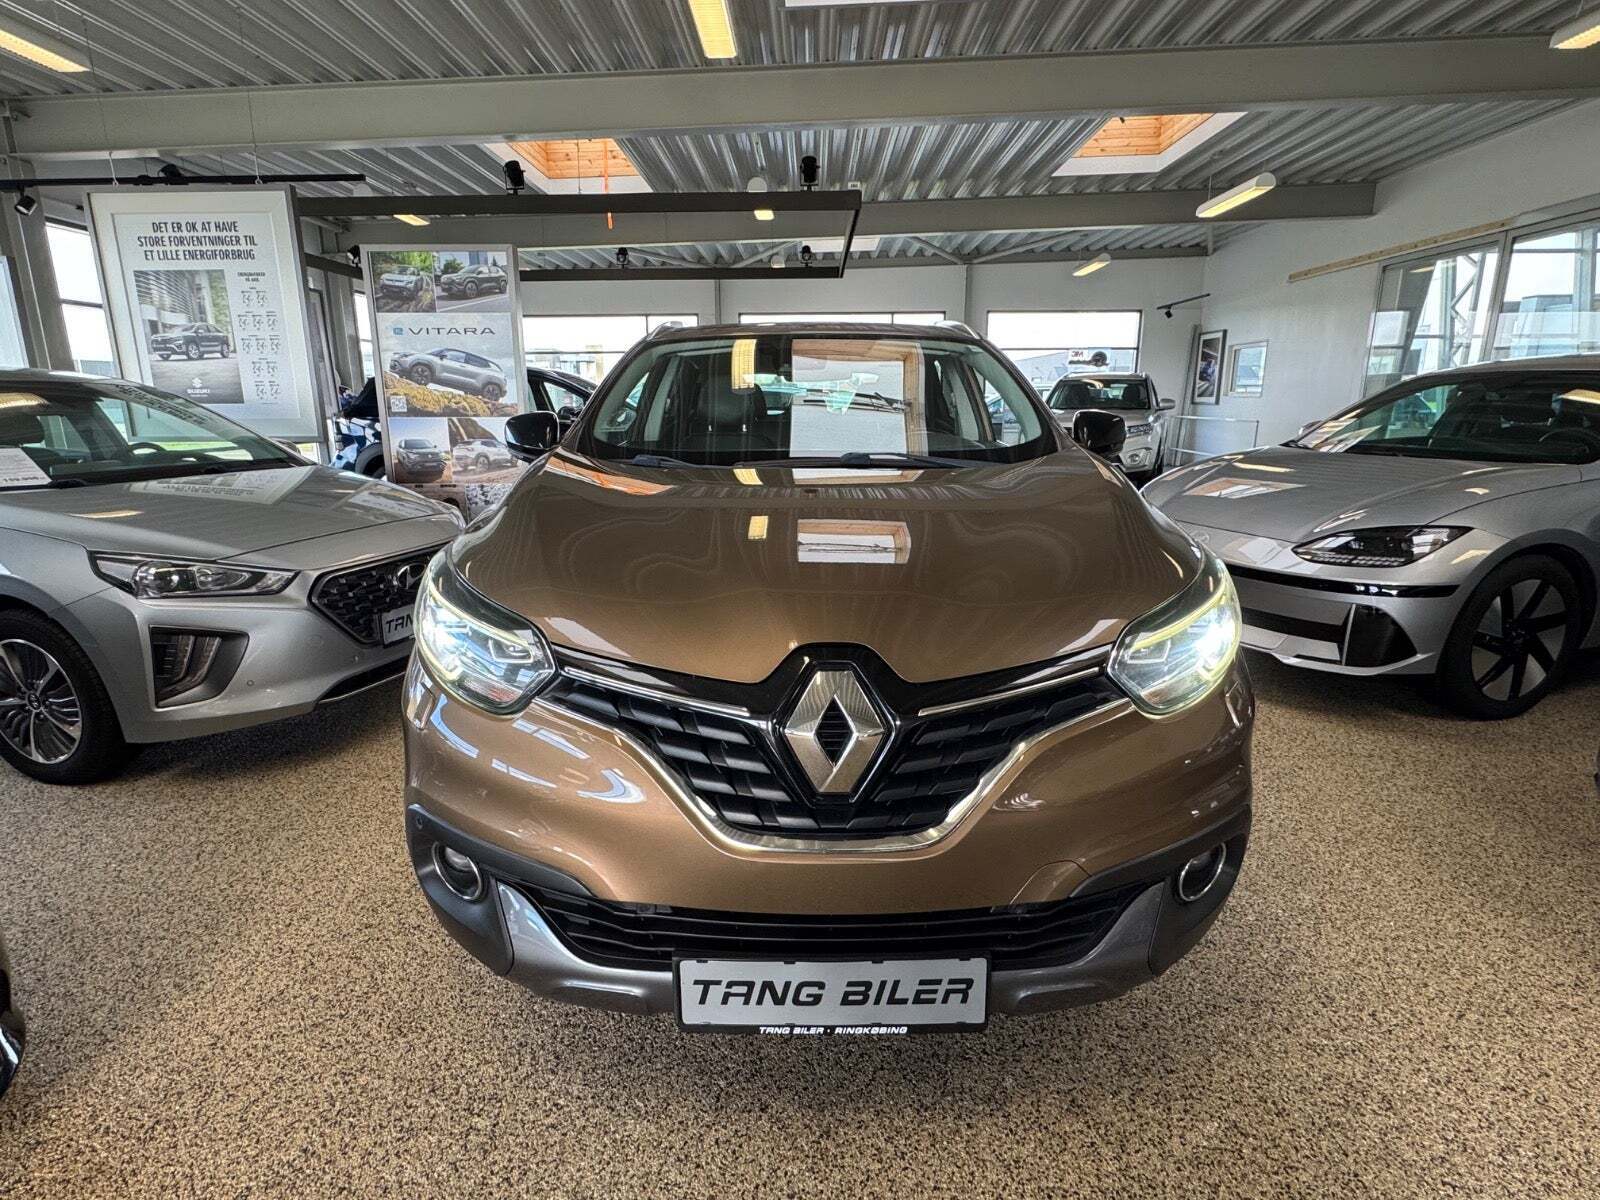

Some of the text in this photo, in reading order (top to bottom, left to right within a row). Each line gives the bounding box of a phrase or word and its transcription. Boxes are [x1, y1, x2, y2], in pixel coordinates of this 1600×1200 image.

[152, 221, 238, 233] DET ER OK AT HAVE
[138, 235, 258, 247] STORE FORVENTNINGER TIL
[144, 249, 255, 260] ET LILLE ENERGIFORBRUG
[408, 327, 495, 335] VITARA
[386, 613, 413, 633] TAN
[692, 977, 974, 1006] TANG BILER
[759, 1026, 908, 1035] TANG BILER RINGKØBING
